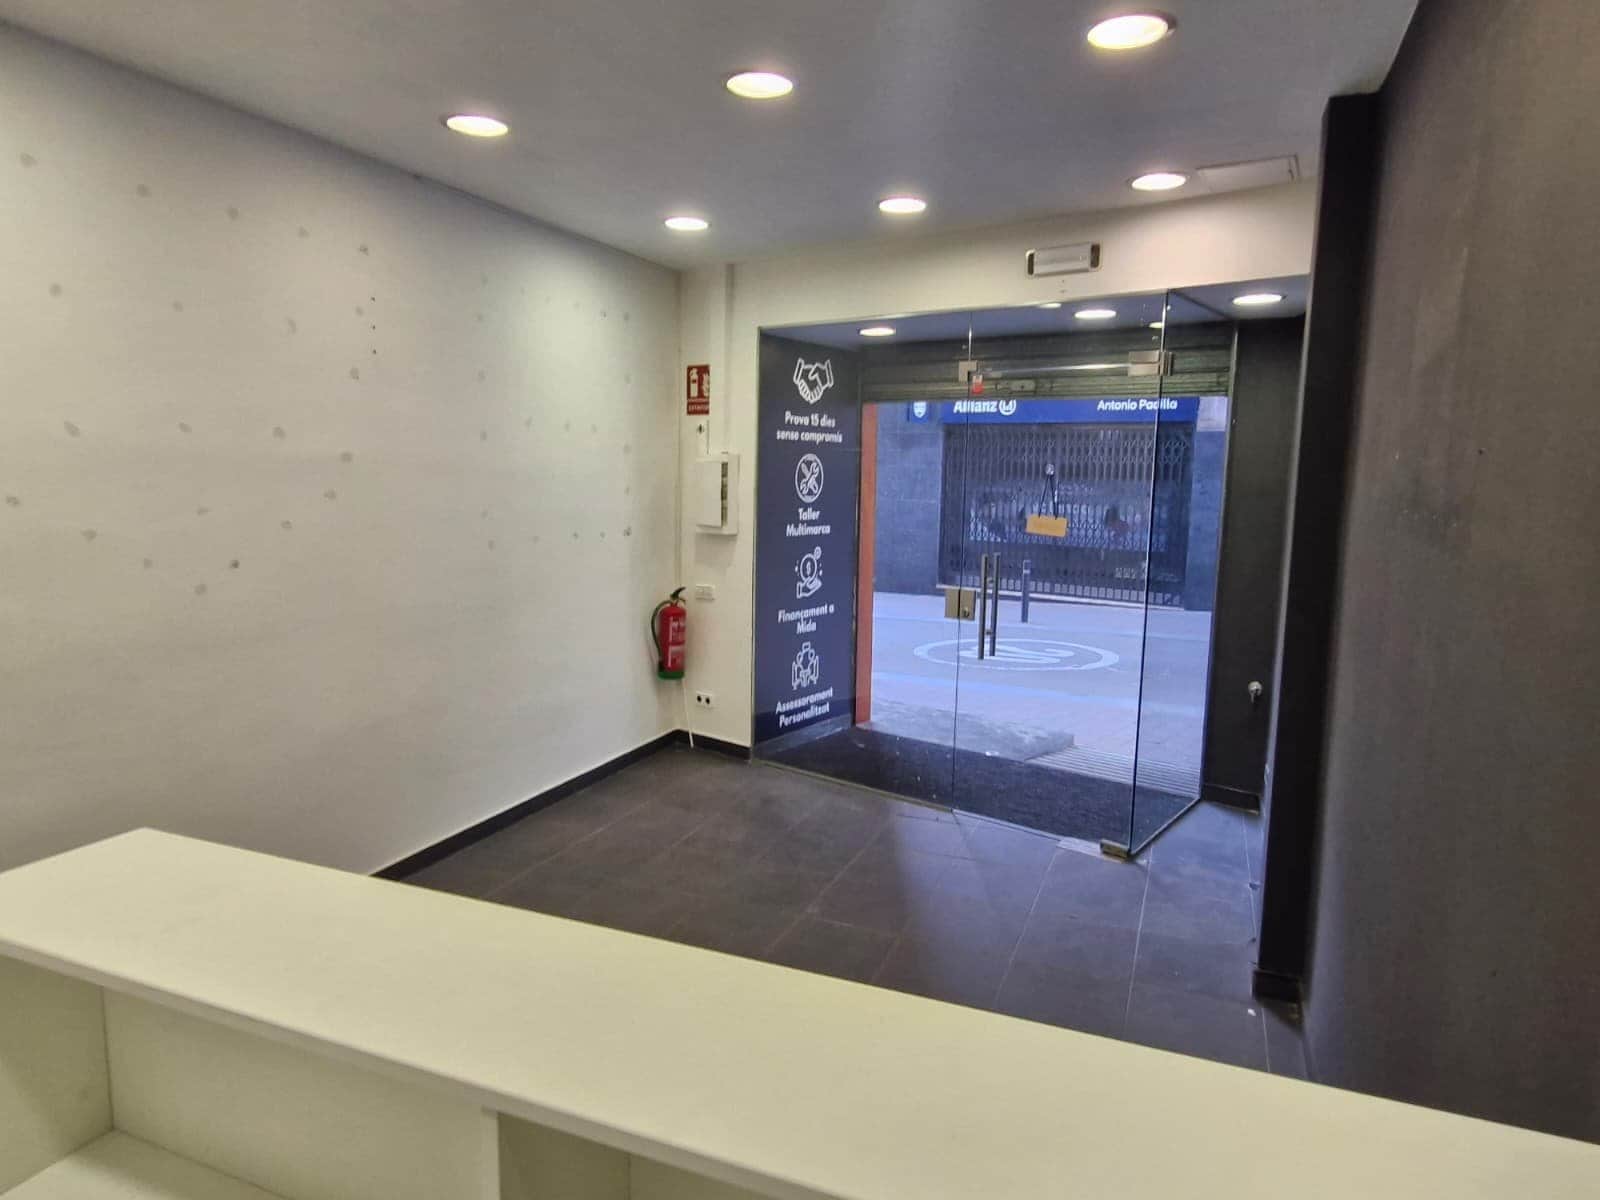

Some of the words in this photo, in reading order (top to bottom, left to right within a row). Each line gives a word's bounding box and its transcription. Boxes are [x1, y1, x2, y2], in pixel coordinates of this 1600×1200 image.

[953, 399, 998, 413] Allianz
[1097, 400, 1137, 411] Antonio
[784, 411, 809, 427] Prova
[810, 413, 819, 427] 15
[820, 414, 835, 428] dies
[776, 430, 799, 441] sense
[798, 508, 820, 522] Taller
[786, 524, 831, 537] Multimarca
[829, 605, 835, 613] a
[796, 620, 817, 635] Mida
[775, 687, 833, 714] Assessorament
[779, 703, 830, 728] Personalitzat
